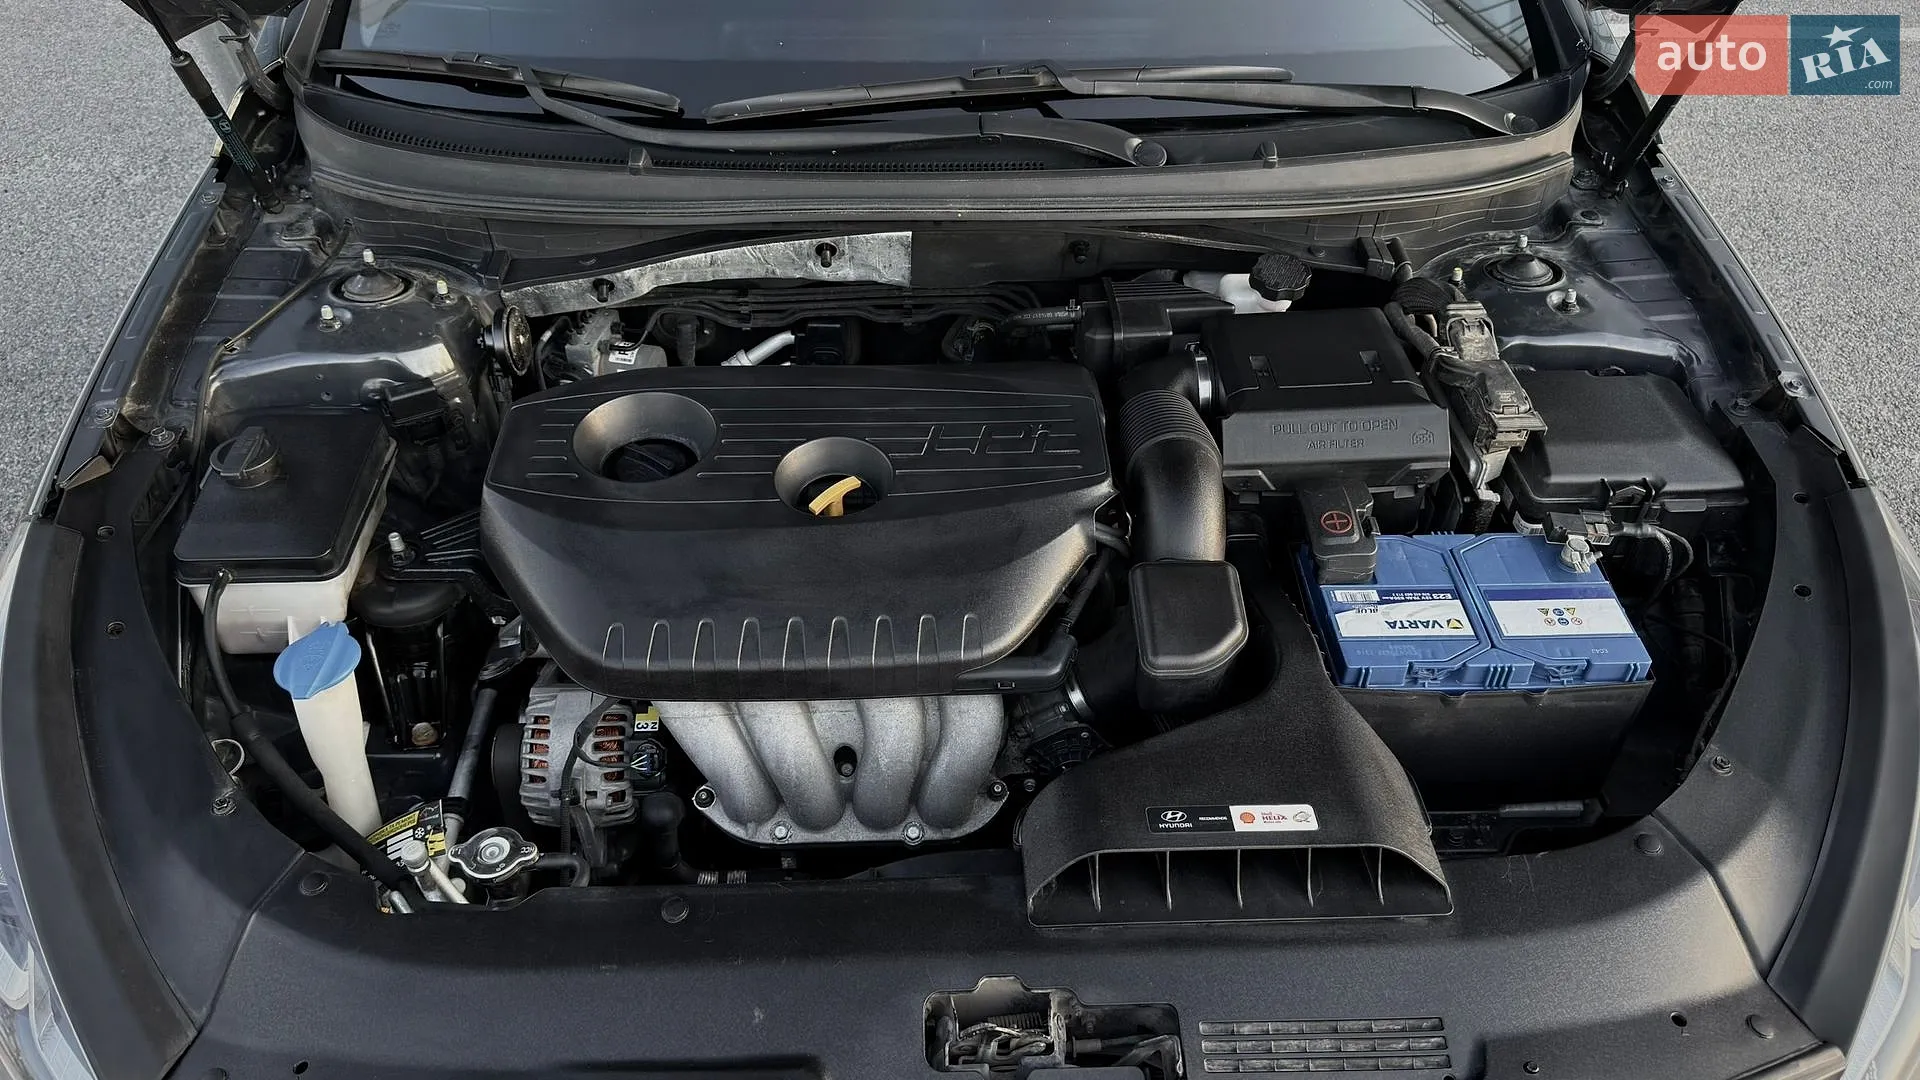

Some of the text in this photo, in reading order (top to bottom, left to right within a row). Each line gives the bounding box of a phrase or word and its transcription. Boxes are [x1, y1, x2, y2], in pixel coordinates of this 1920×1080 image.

[1272, 418, 1399, 435] PULL OUT TO OPEN
[1306, 438, 1364, 449] AIR FILTER
[1386, 620, 1444, 629] VARTA
